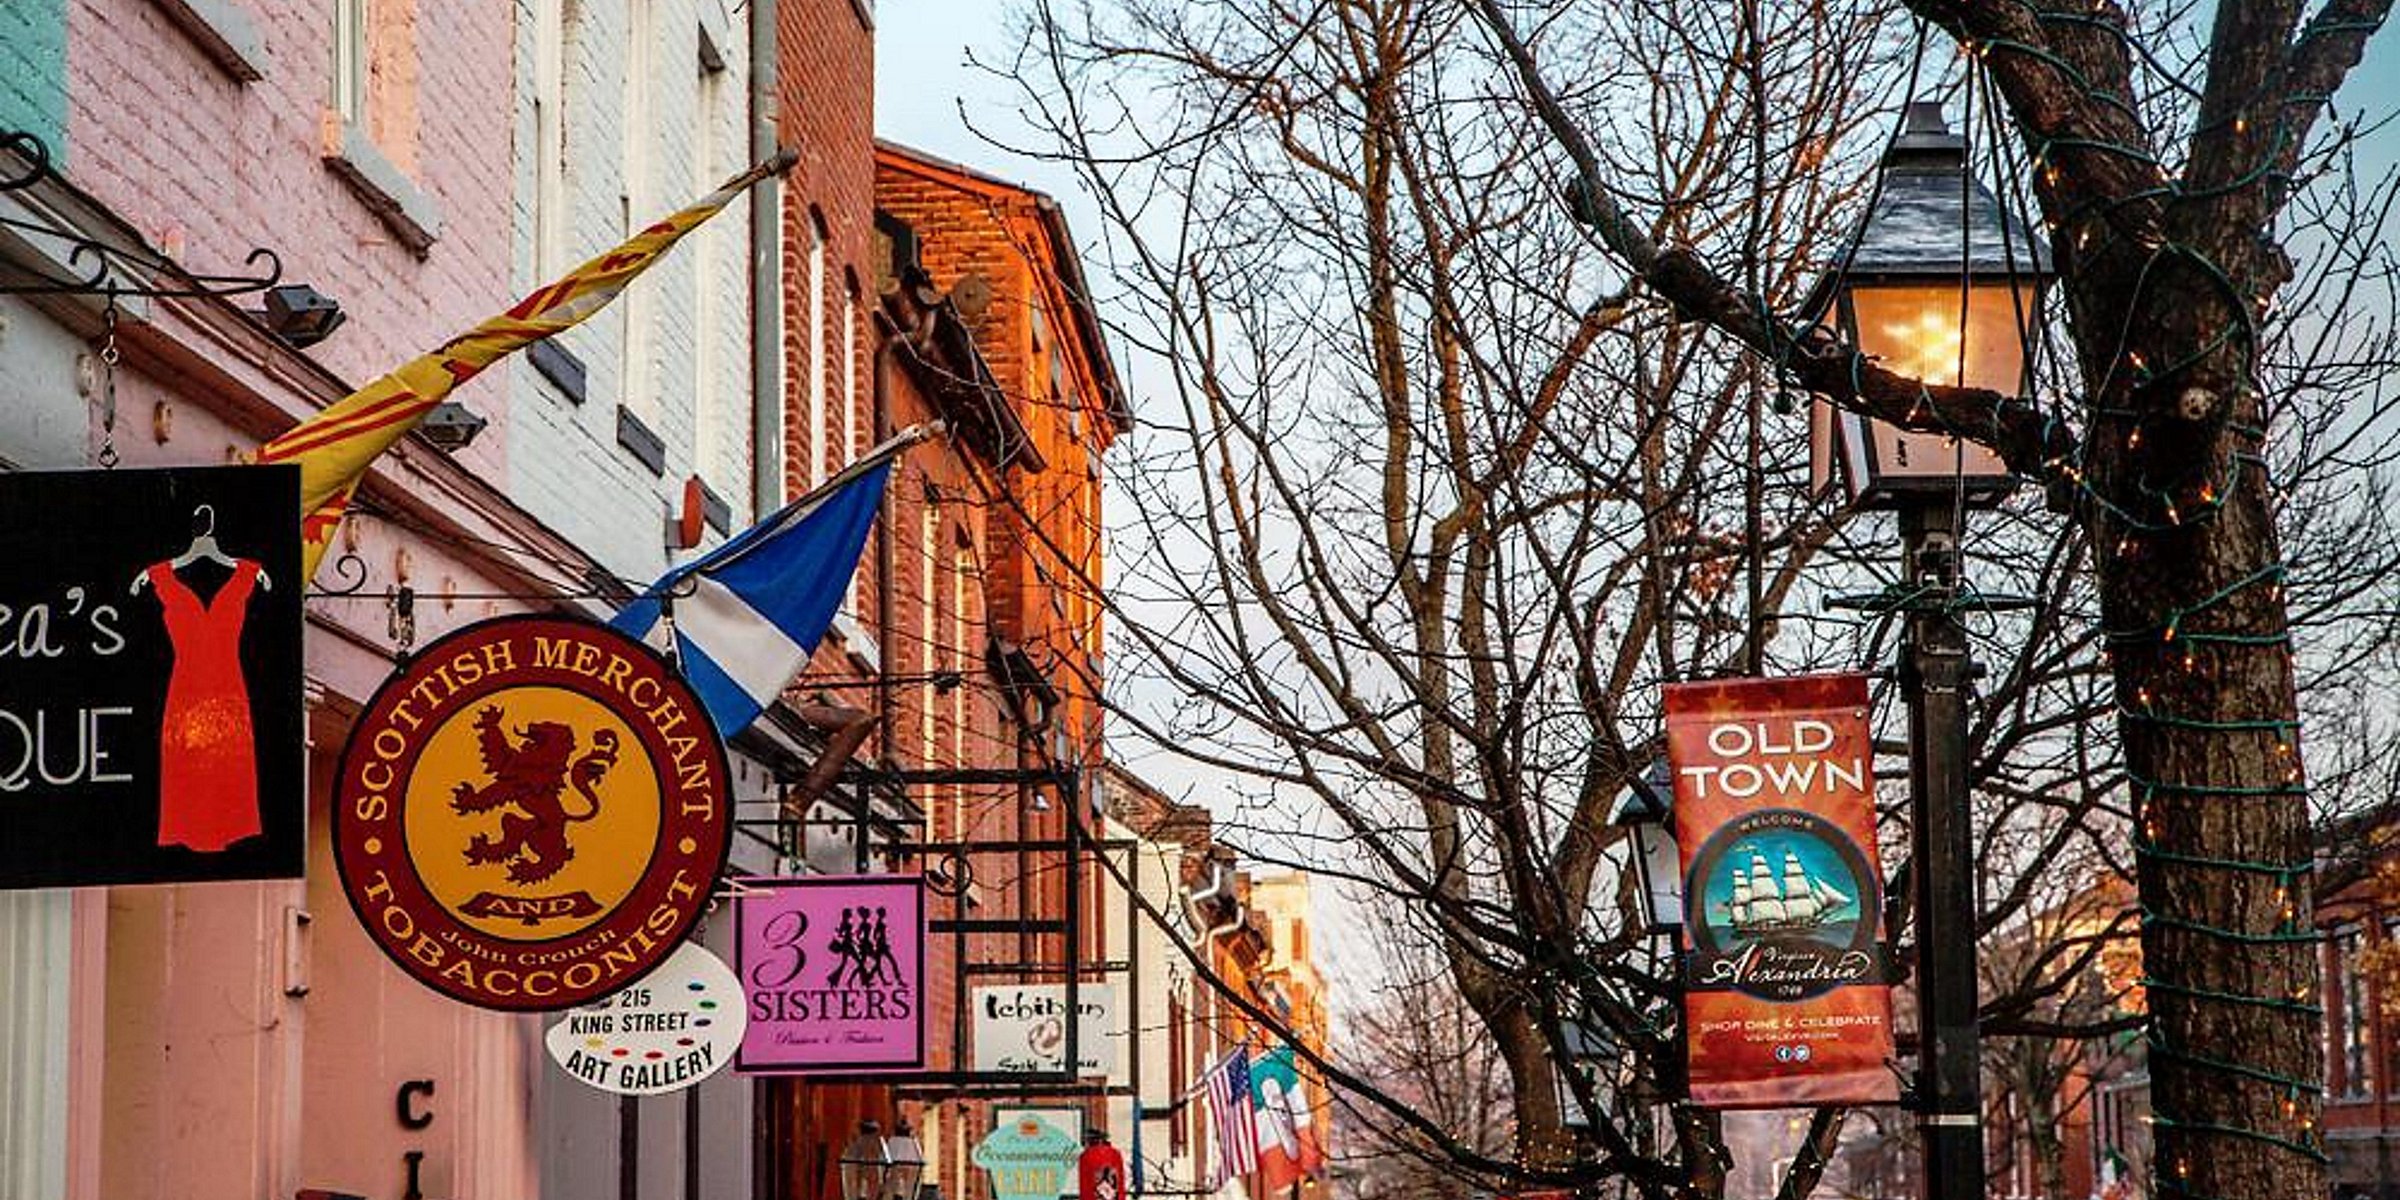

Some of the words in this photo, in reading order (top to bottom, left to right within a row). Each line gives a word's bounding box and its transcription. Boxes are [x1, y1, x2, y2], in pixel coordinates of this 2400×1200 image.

[357, 638, 517, 821] SCOTTISH
[534, 636, 713, 822] MERCHANT
[1708, 720, 1834, 757] OLD
[1680, 758, 1865, 798] TOWN
[487, 899, 576, 915] AND
[363, 869, 697, 997] TOBACCONIST
[441, 928, 507, 965] John
[517, 928, 617, 965] Crouch
[752, 909, 809, 989] 3
[1701, 943, 1871, 984] Alexandria
[621, 989, 652, 1008] 215
[752, 988, 911, 1022] SISTERS
[570, 1015, 613, 1034] KING
[621, 1011, 688, 1032] STREET
[1744, 1017, 1780, 1031] DINE
[1799, 1015, 1882, 1028] CELEBRATE
[566, 1049, 612, 1084] ART
[619, 1041, 714, 1089] GALLERY
